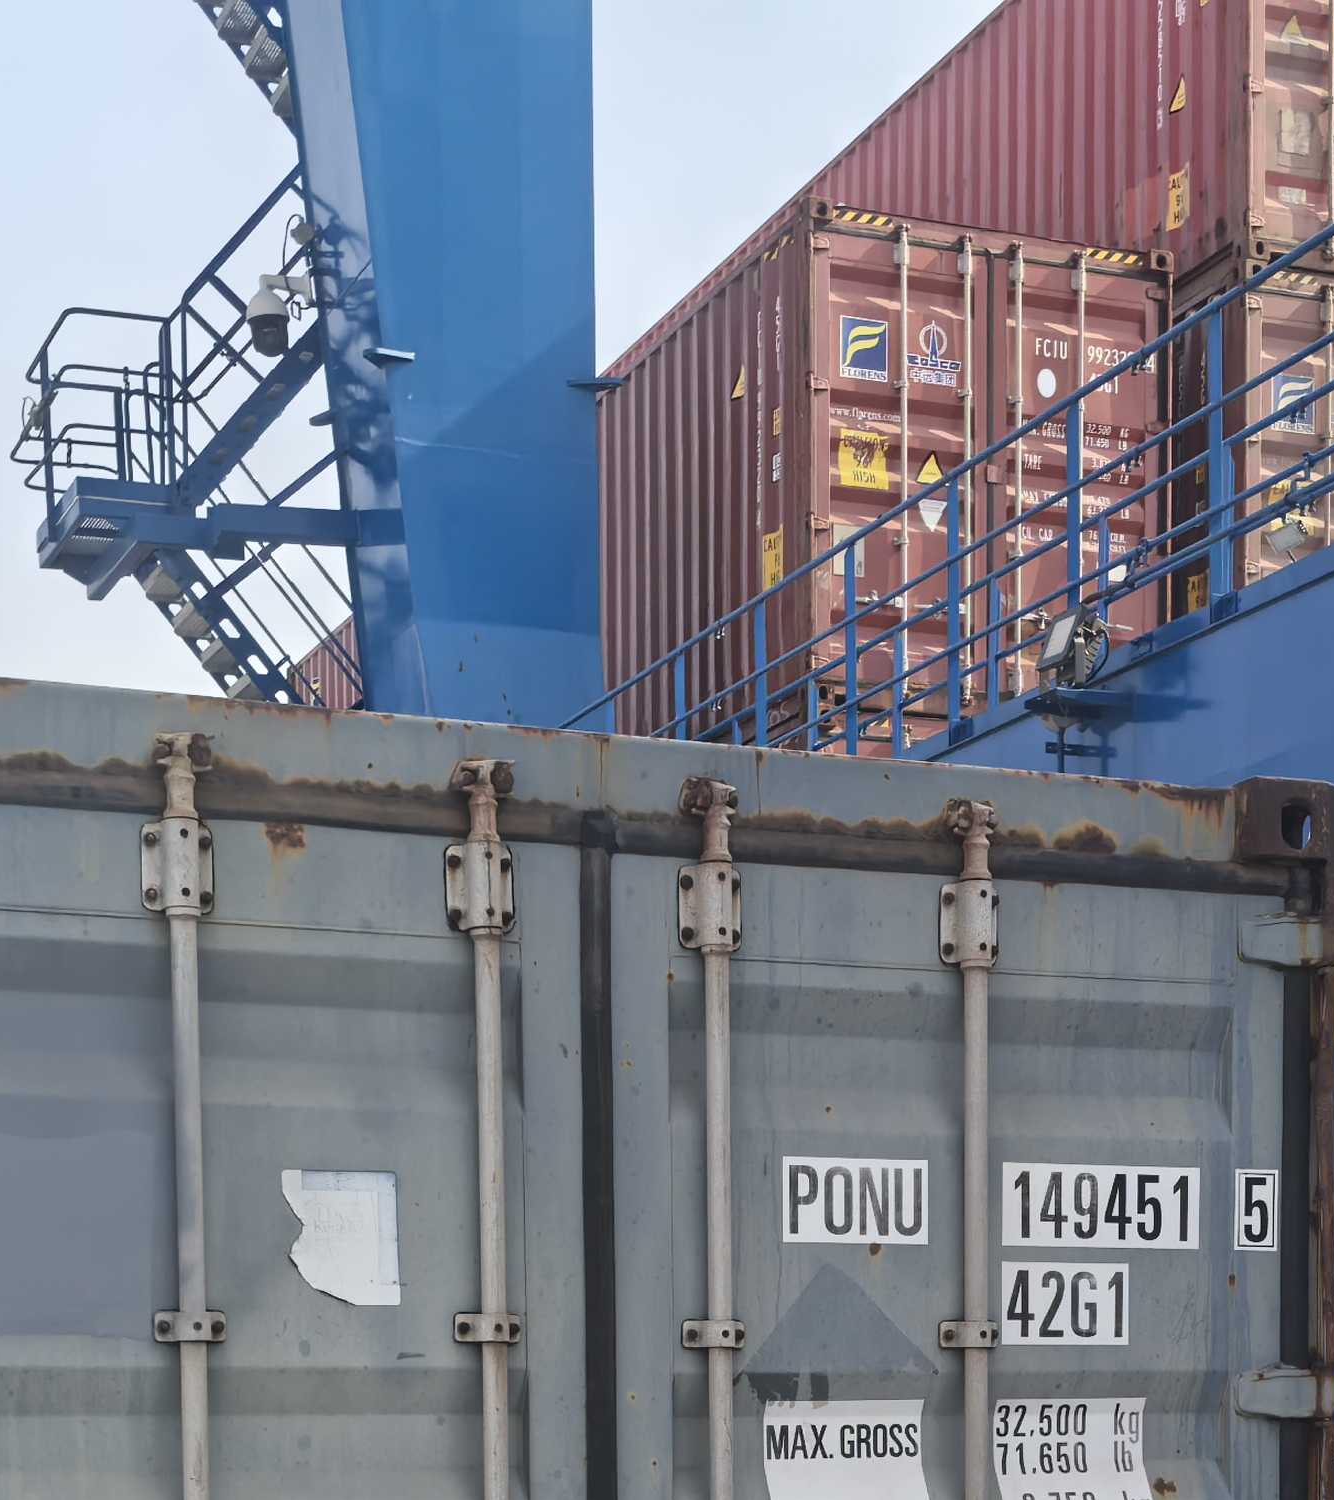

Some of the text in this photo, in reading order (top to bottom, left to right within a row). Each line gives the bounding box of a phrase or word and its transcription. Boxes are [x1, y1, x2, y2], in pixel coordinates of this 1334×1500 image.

[1035, 337, 1068, 360] FCIU
[841, 366, 886, 380] FLORENS
[789, 1164, 1267, 1243] PONU 149451 5
[1007, 1270, 1124, 1338] 42G1
[766, 1403, 1140, 1460] MAX. GROSS 32,500 kg
[1114, 1441, 1133, 1473] lb
